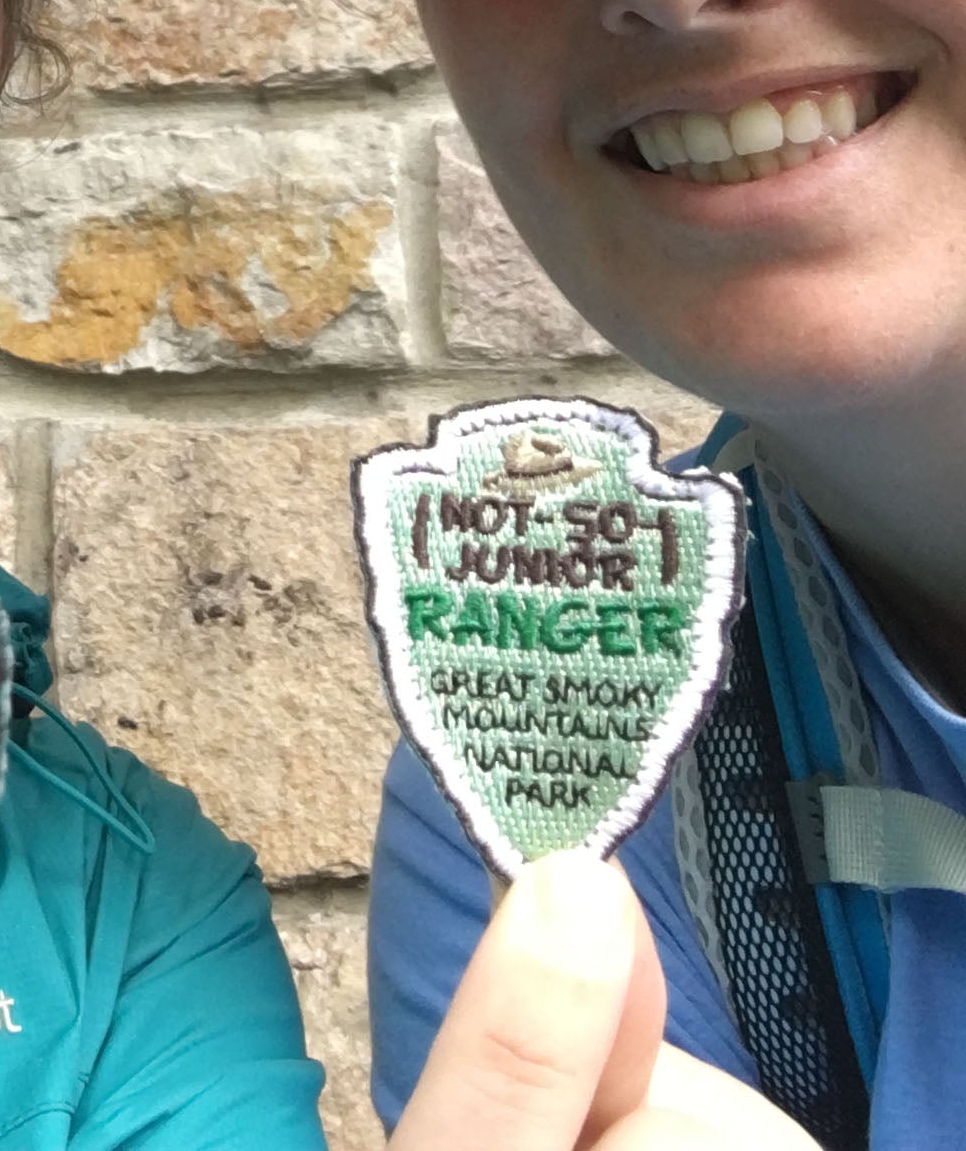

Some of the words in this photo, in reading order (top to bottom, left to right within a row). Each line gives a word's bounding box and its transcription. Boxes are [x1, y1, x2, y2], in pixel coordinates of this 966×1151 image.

[446, 542, 637, 591] JUNIOR
[405, 586, 685, 657] RANGER
[431, 669, 535, 701] GREAT
[546, 674, 661, 709] SMOKY
[444, 704, 652, 742] MOUNTAINS
[465, 746, 637, 780] NATIONAL
[505, 777, 591, 808] PARK
